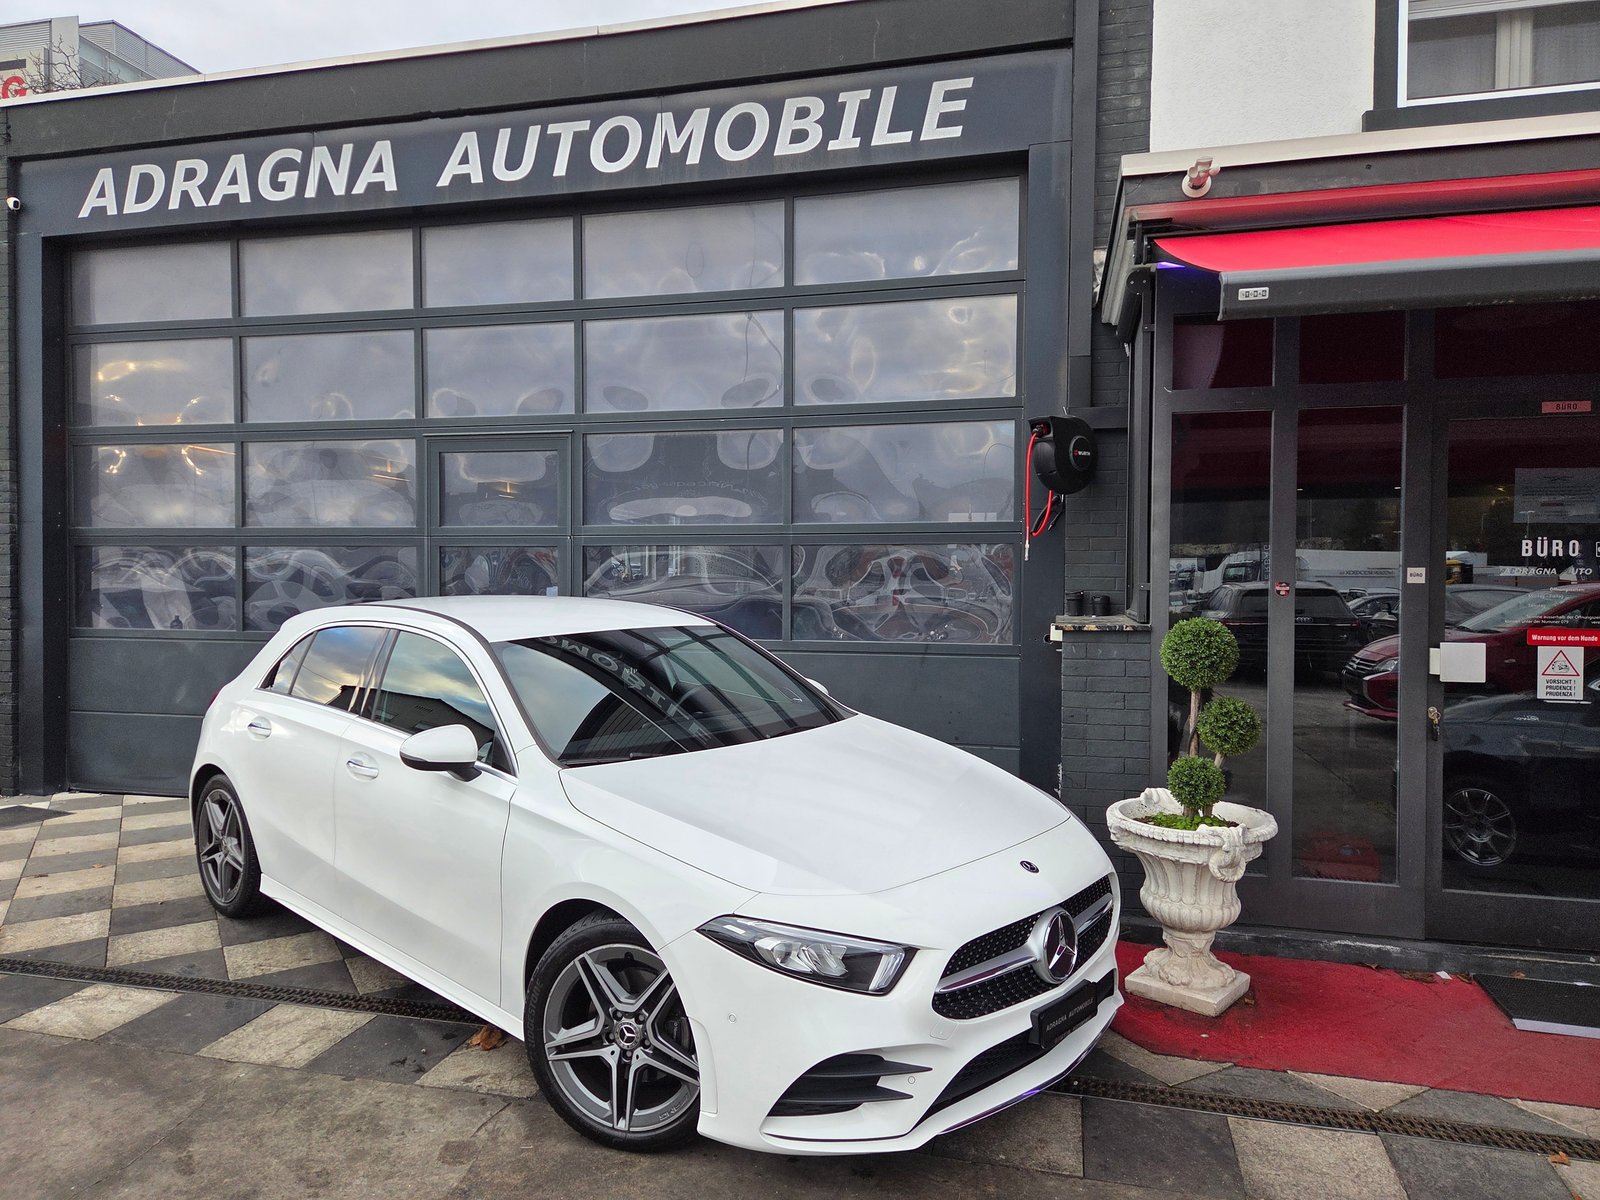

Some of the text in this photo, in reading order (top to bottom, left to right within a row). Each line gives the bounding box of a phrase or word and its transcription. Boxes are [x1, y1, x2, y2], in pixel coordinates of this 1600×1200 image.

[78, 77, 974, 218] ADRAGNA AUTOMOBILE
[1521, 536, 1580, 557] BÜRO
[1531, 634, 1557, 642] Warnung
[526, 978, 544, 1056] IDGESTONE
